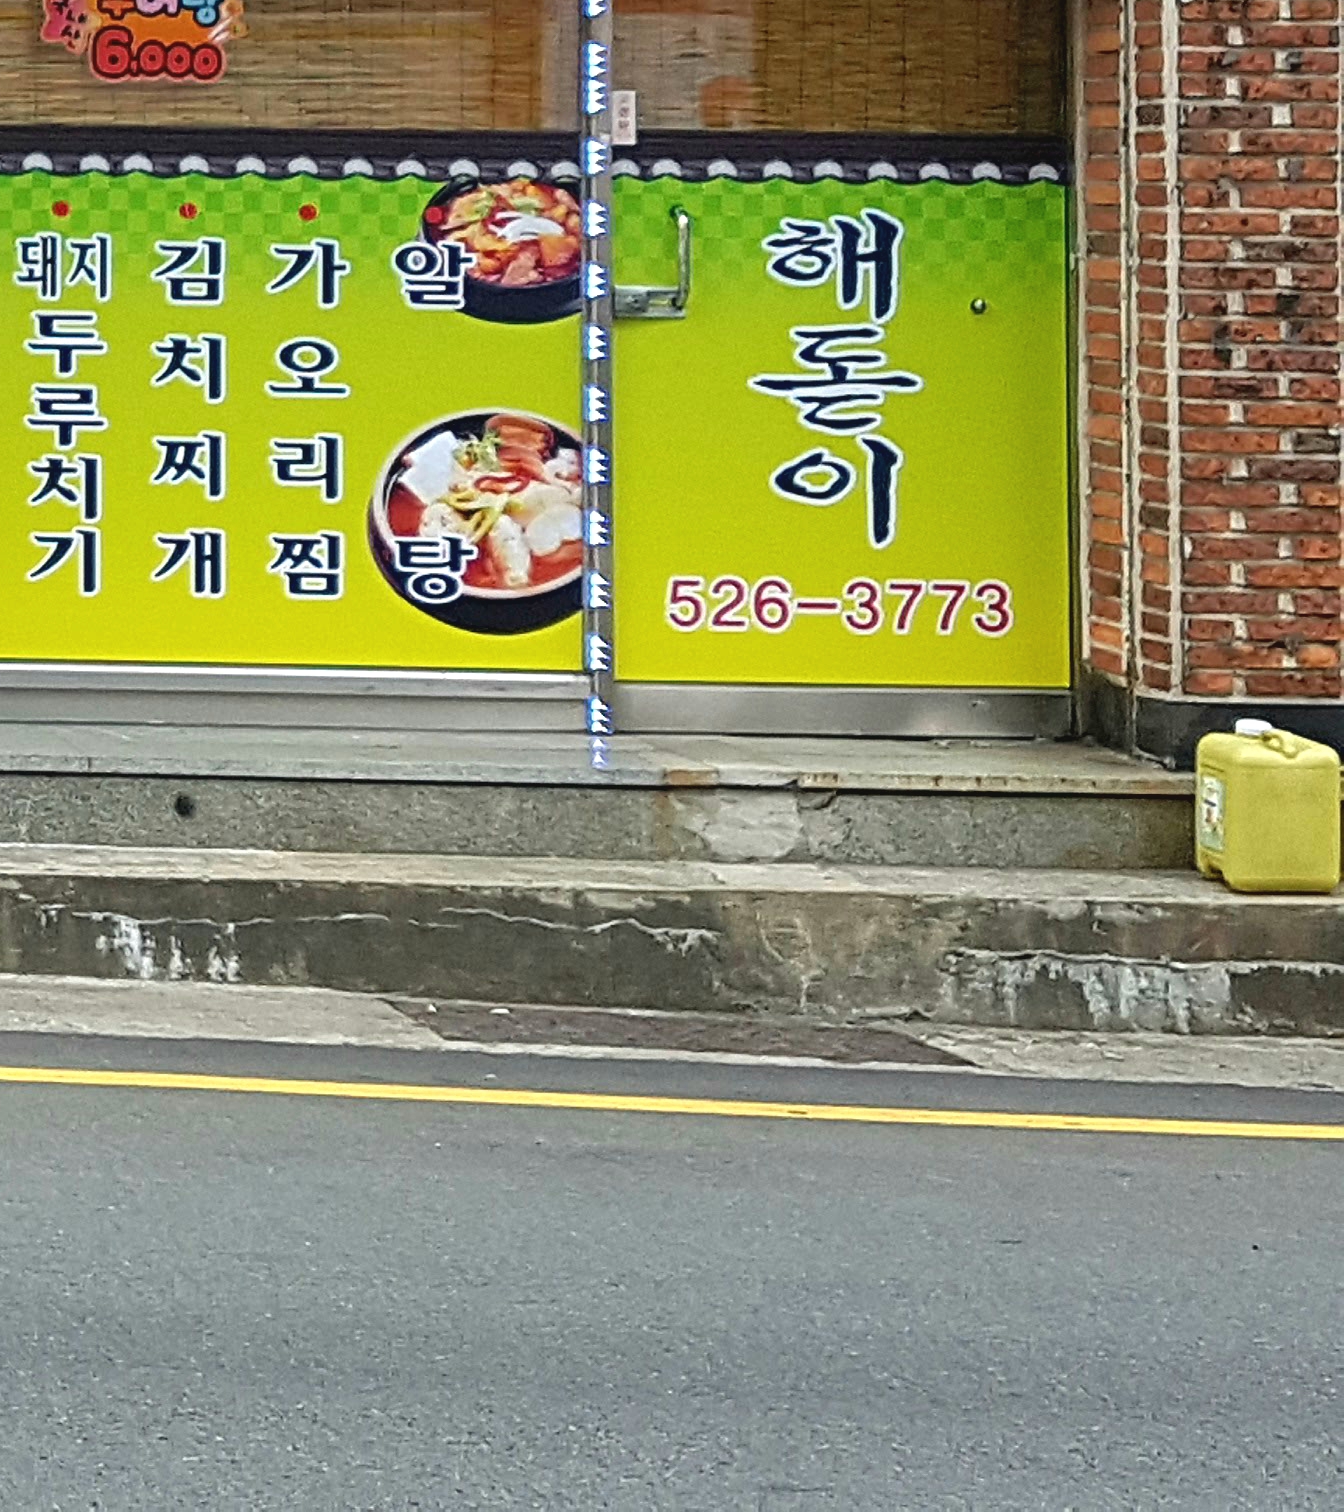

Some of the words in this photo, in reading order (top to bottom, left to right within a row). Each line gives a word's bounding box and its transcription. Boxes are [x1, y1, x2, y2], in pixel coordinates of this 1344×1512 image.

[150, 236, 227, 599] 김치찌개
[263, 238, 352, 600] 가오리찜
[748, 207, 924, 549] 해돋이
[665, 575, 1014, 636] 526-3773
